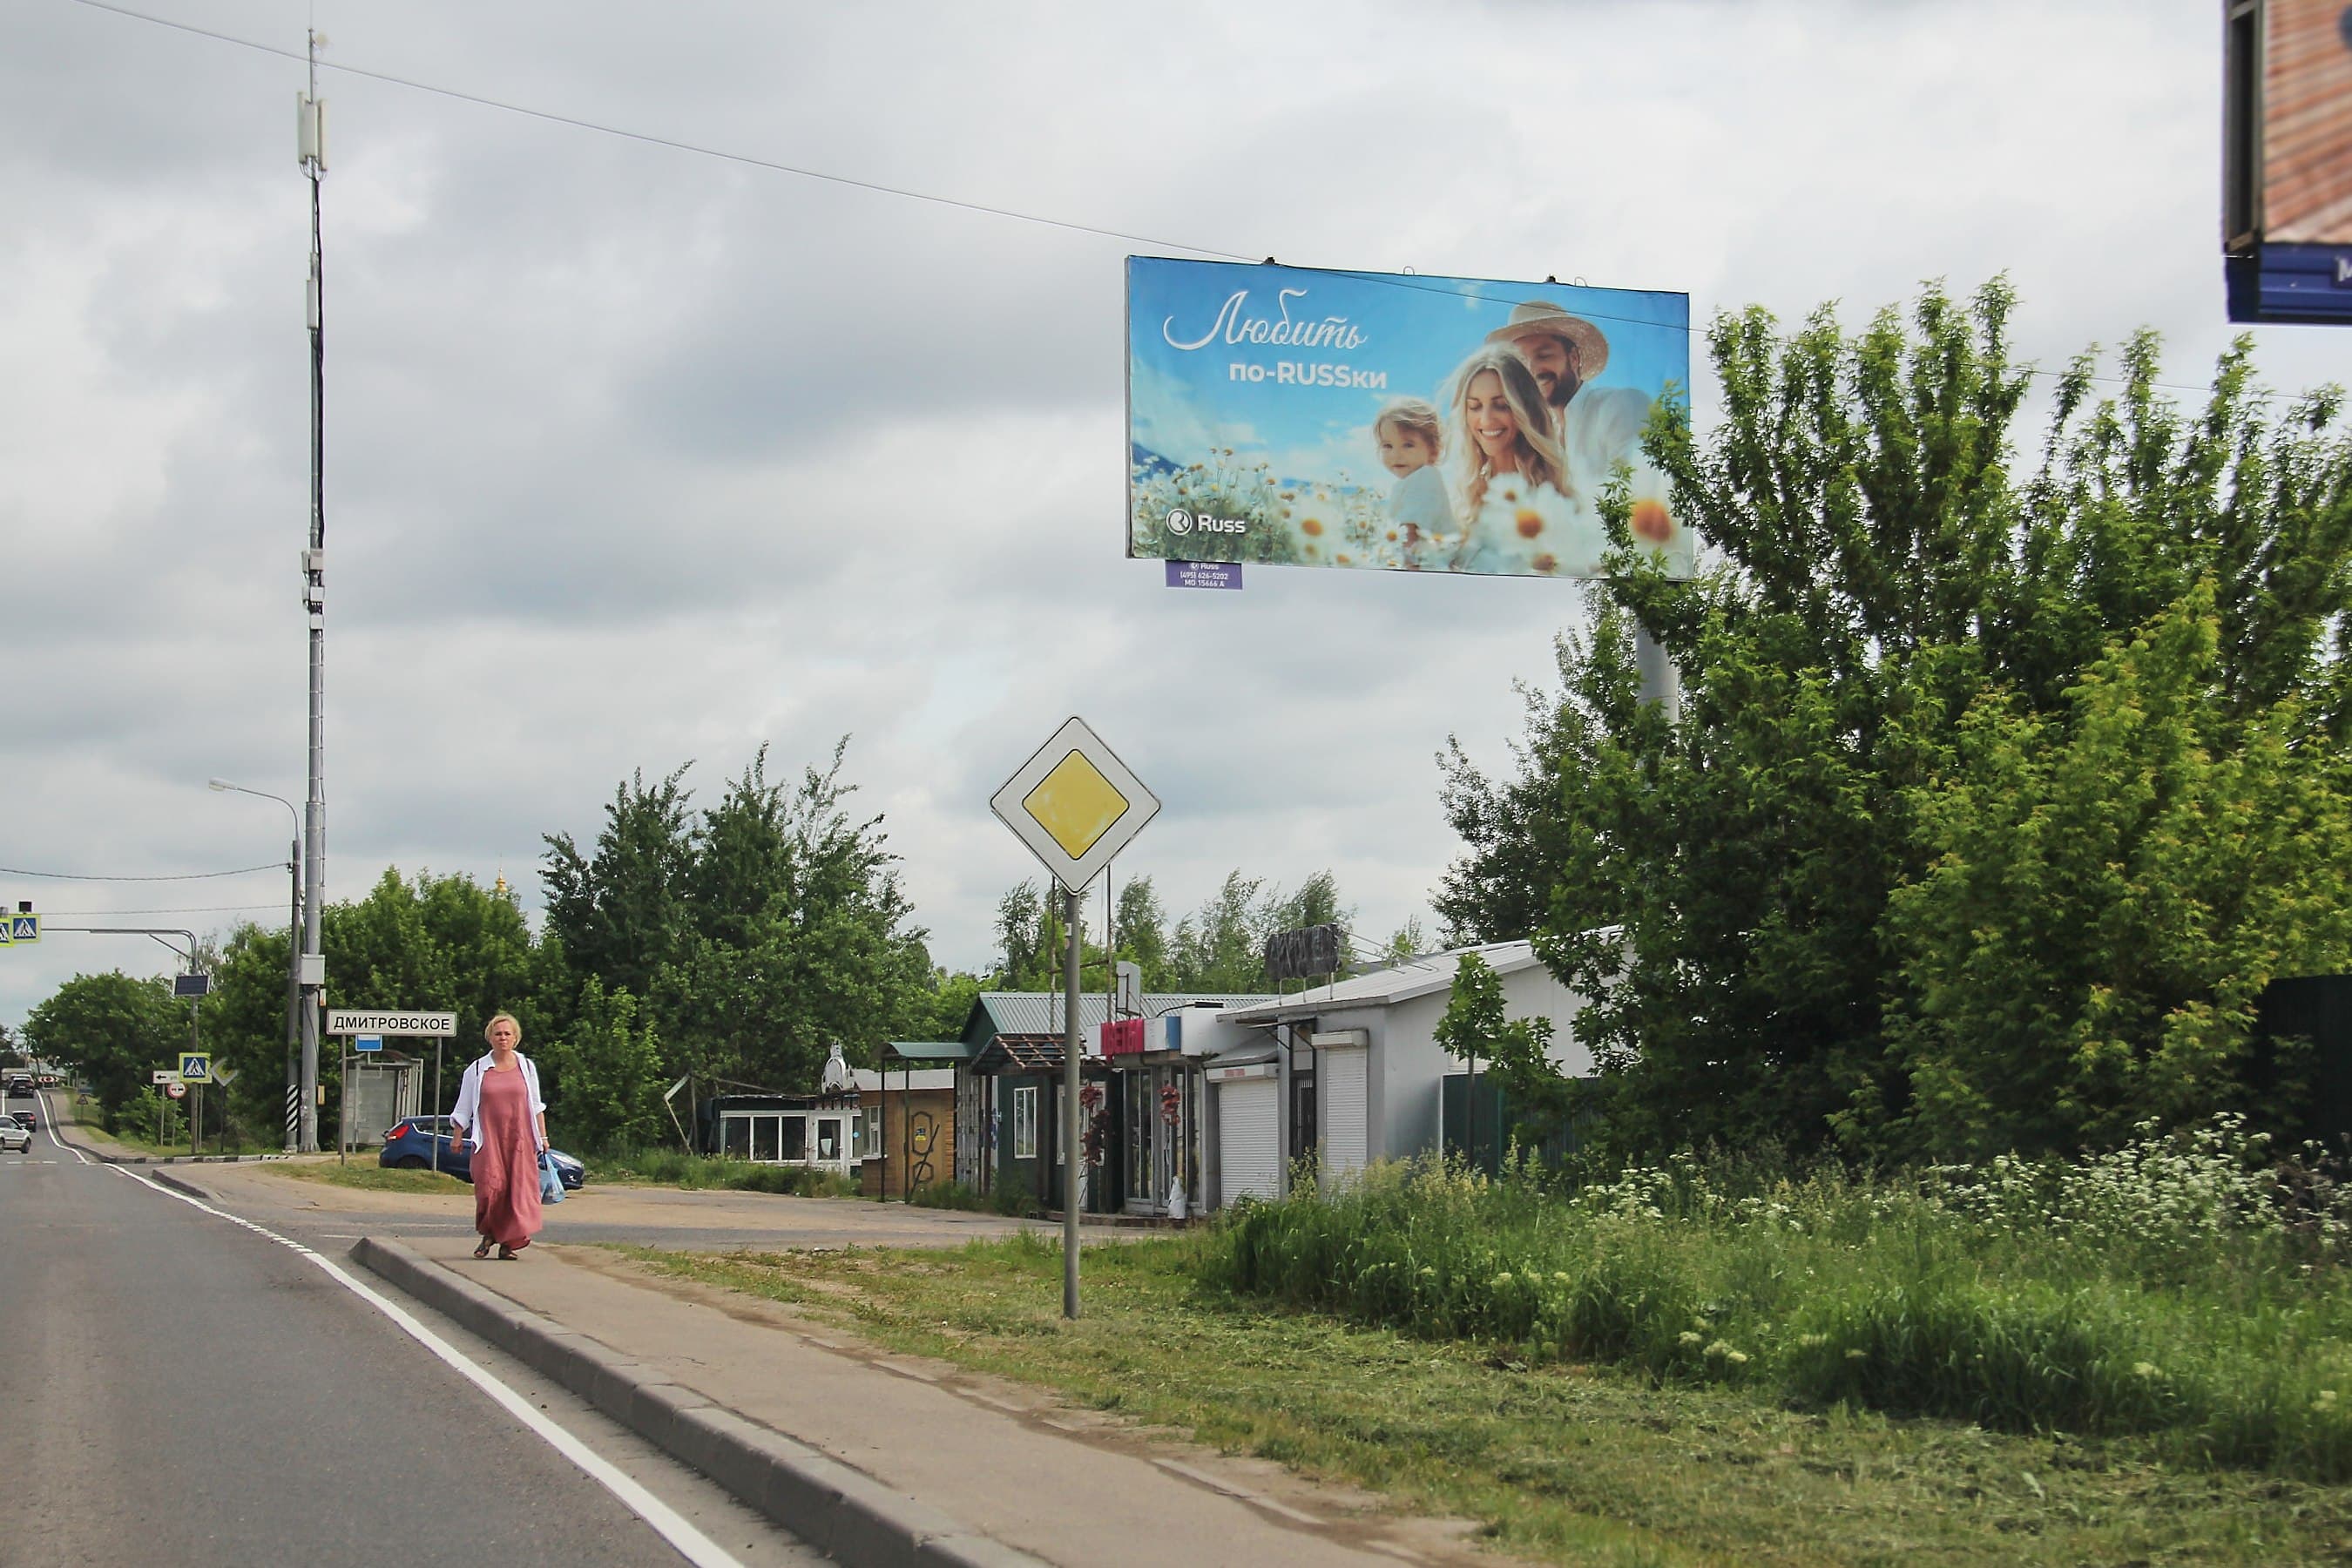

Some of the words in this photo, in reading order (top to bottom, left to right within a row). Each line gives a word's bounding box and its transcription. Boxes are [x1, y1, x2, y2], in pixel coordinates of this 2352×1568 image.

[1163, 288, 1369, 350] Любить
[1229, 362, 1387, 389] по-RUSSки
[1198, 514, 1246, 533] Russ
[334, 1017, 450, 1031] ДМИТРОВСКОЕ
